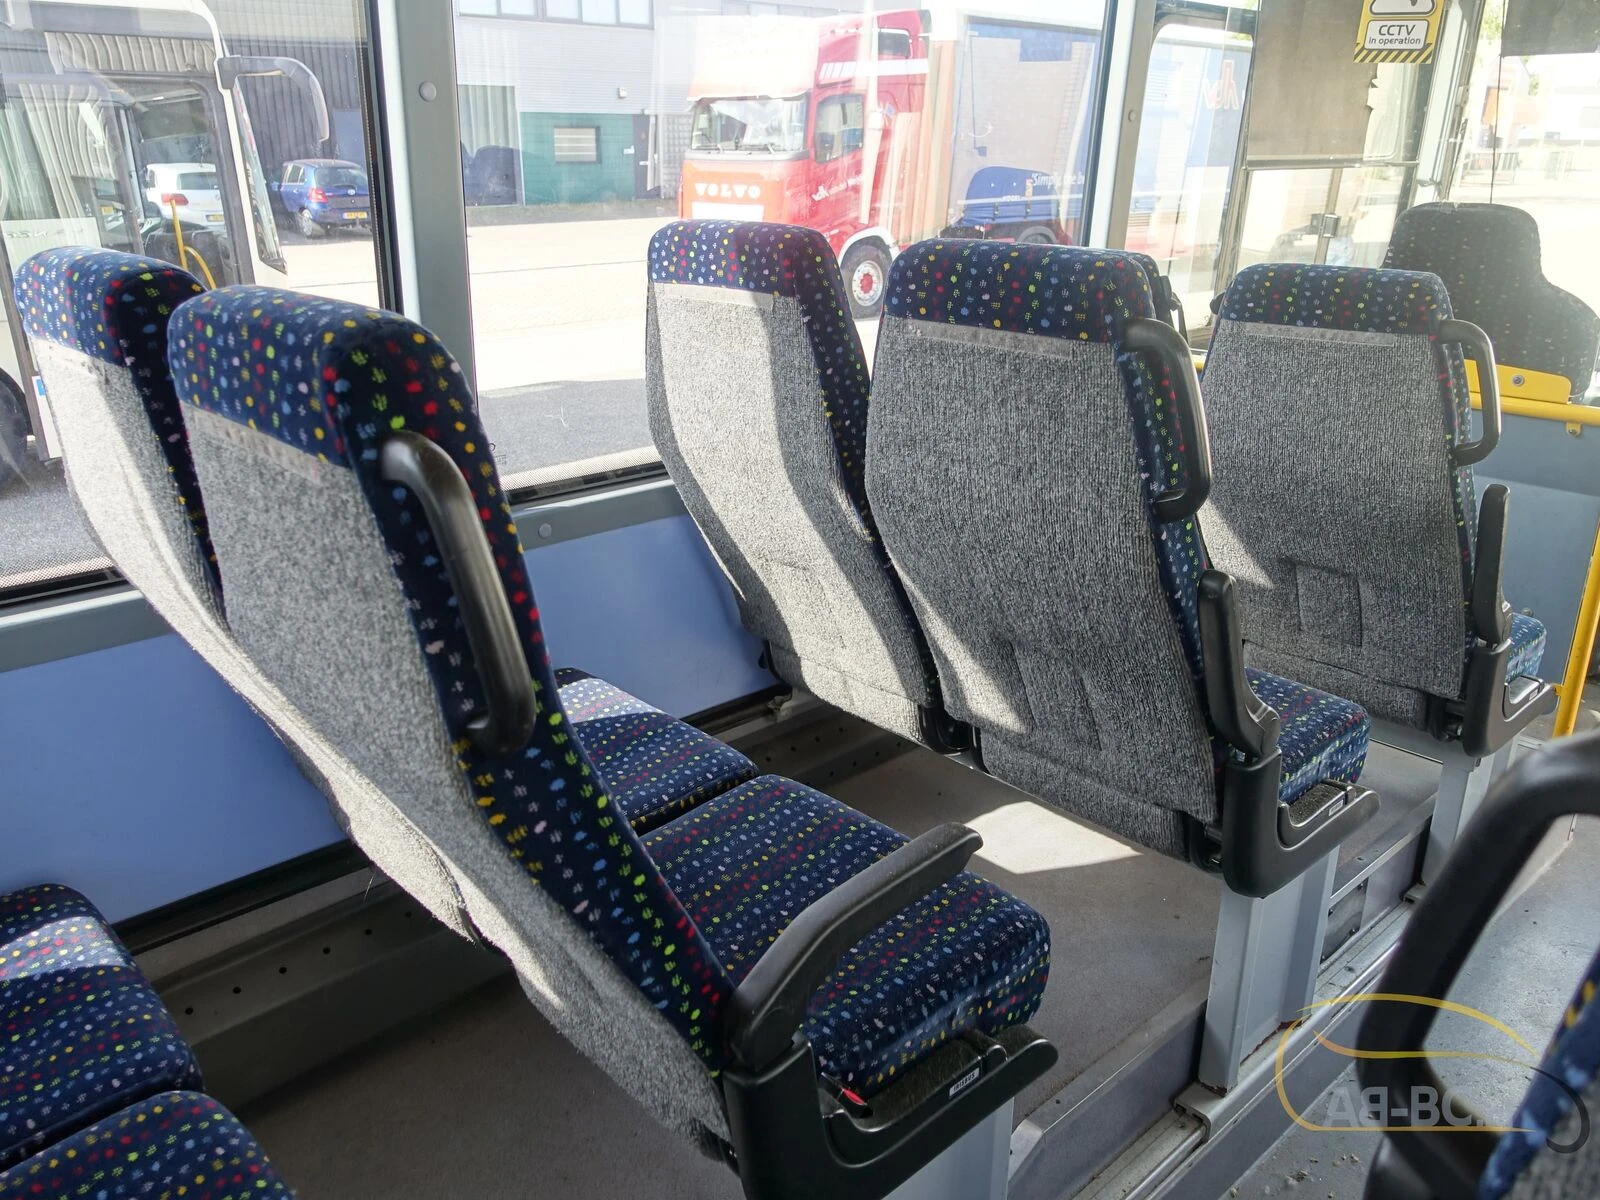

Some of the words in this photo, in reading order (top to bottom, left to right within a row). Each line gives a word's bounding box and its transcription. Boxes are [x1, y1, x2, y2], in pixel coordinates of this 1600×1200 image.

[1378, 24, 1416, 36] CCTV
[1368, 37, 1376, 45] in
[1378, 36, 1421, 46] operation
[694, 182, 761, 199] VOLVO
